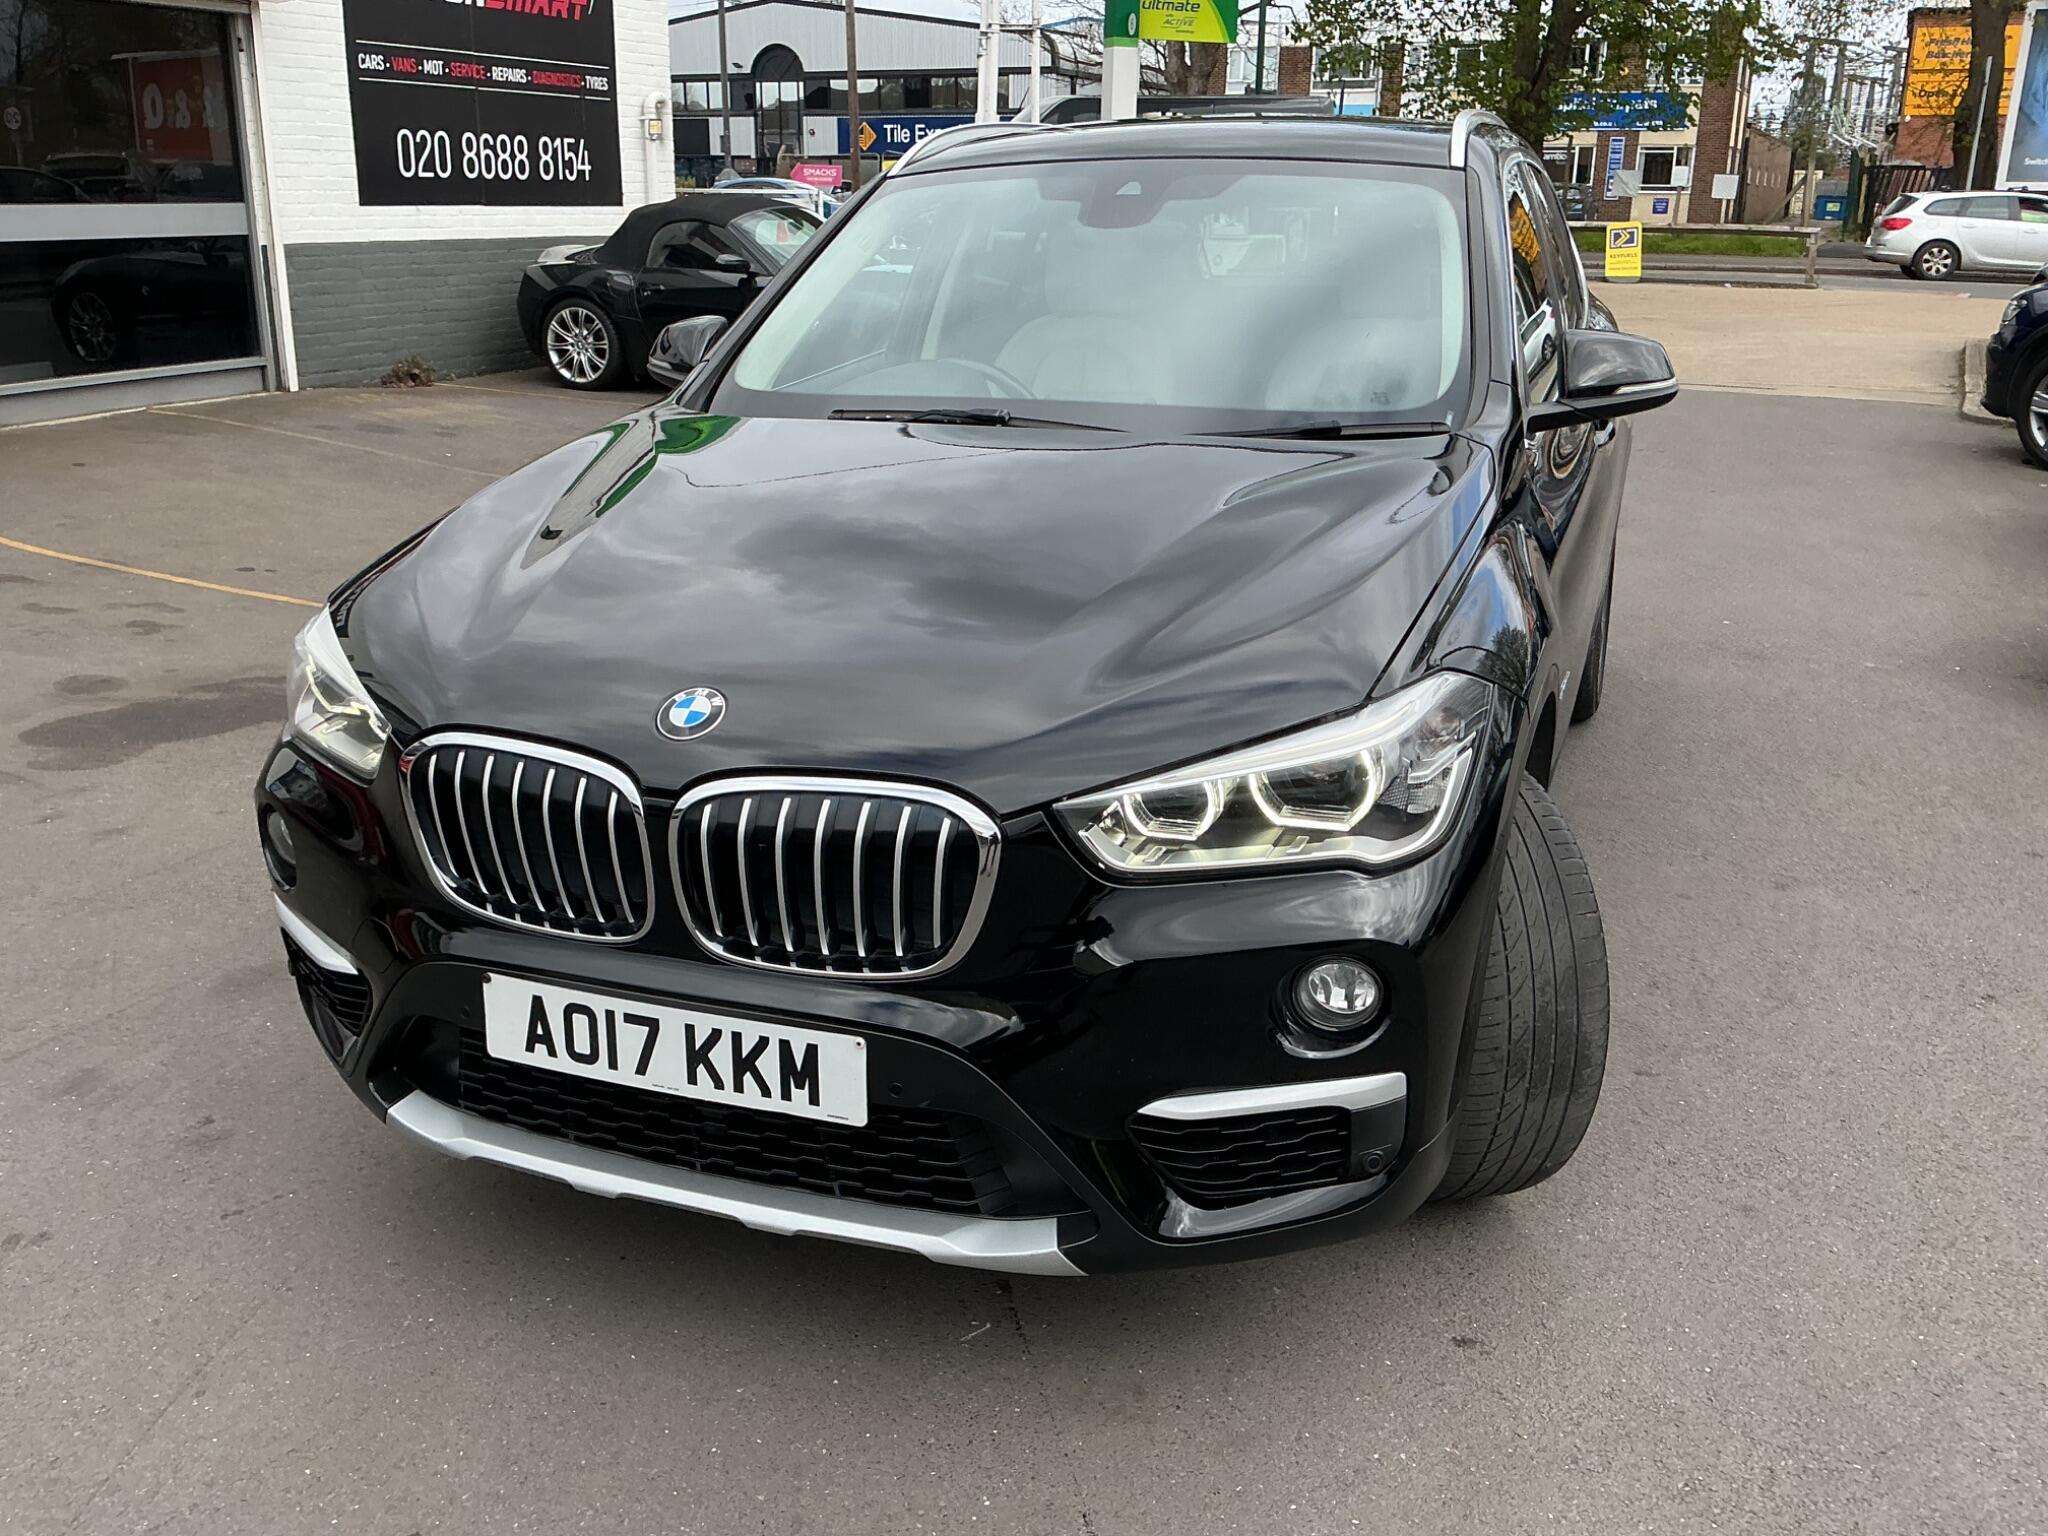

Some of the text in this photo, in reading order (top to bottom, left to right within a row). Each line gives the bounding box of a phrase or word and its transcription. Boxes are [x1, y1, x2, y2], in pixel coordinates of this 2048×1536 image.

[358, 53, 384, 70] CARS
[391, 56, 417, 73] VANS
[423, 60, 443, 75] MOT
[450, 62, 486, 80] SERVICE
[492, 66, 527, 83] REPAIRS
[586, 75, 609, 90] TYRES
[883, 124, 911, 143] Tile
[397, 128, 592, 181] 020 8688 8154
[803, 168, 837, 177] SMACKS
[525, 994, 821, 1107] AO17 KKM
